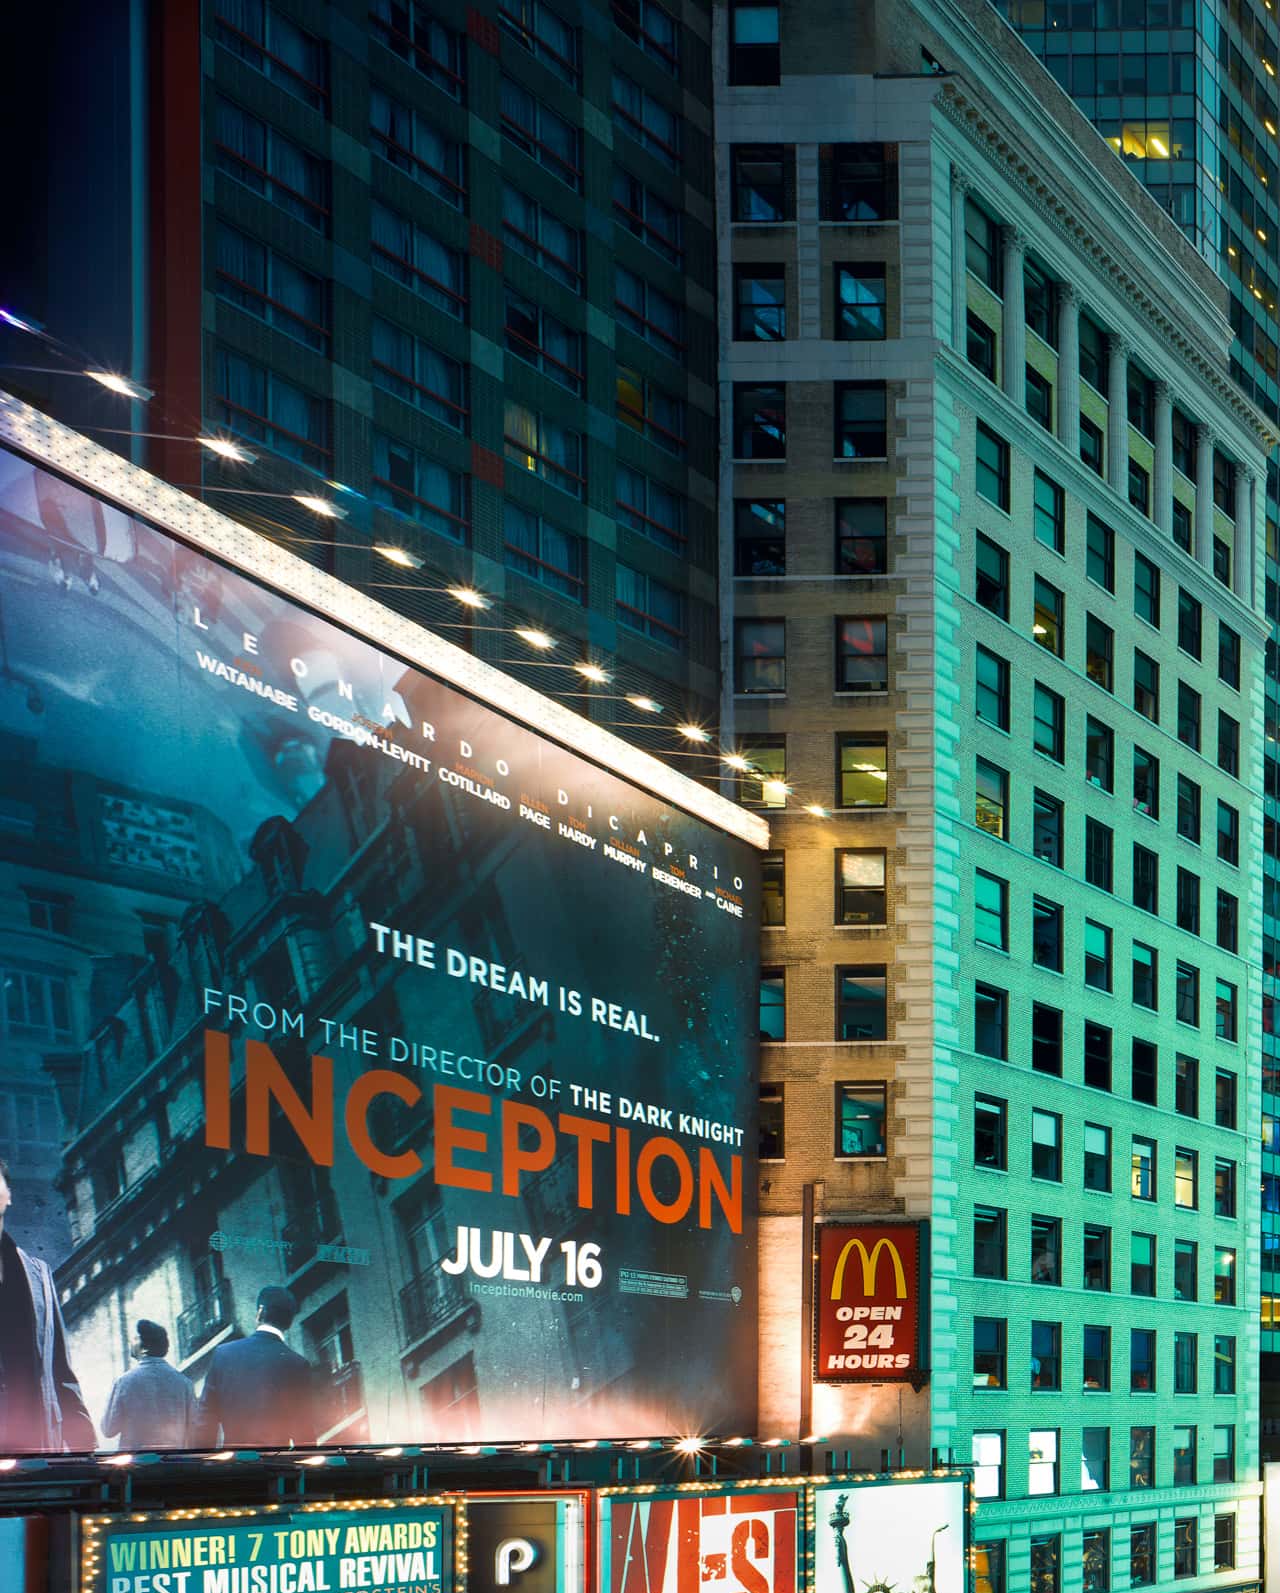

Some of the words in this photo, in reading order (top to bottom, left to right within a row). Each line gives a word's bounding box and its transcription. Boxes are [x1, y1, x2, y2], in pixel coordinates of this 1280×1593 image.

[196, 650, 299, 712] WATANABE
[308, 706, 432, 773] GORDON-LEVITT
[439, 768, 511, 811] COTILLARD
[520, 804, 551, 830] PAGE
[558, 822, 597, 850] HARDY
[604, 845, 646, 873] MURPHY
[652, 867, 702, 899] BERENGER
[716, 897, 743, 919] CAINE
[558, 788, 744, 891] DICAPRIO
[370, 922, 436, 969] THE
[448, 948, 549, 1006] DREAM
[592, 998, 661, 1042] REAL.
[391, 1036, 522, 1093] DIRECTOR
[618, 1097, 673, 1131] DARK
[679, 1113, 744, 1147] KNIGHT
[204, 1029, 743, 1235] INCEPTION
[441, 1226, 552, 1284] JULY
[560, 1240, 603, 1290] 16
[836, 1306, 903, 1321] OPEN
[843, 1324, 894, 1349] 24
[828, 1354, 910, 1369] HOURS
[110, 1533, 237, 1573] WINNER!
[344, 1521, 440, 1555] AWARDS
[339, 1550, 439, 1589] REVIVAL
